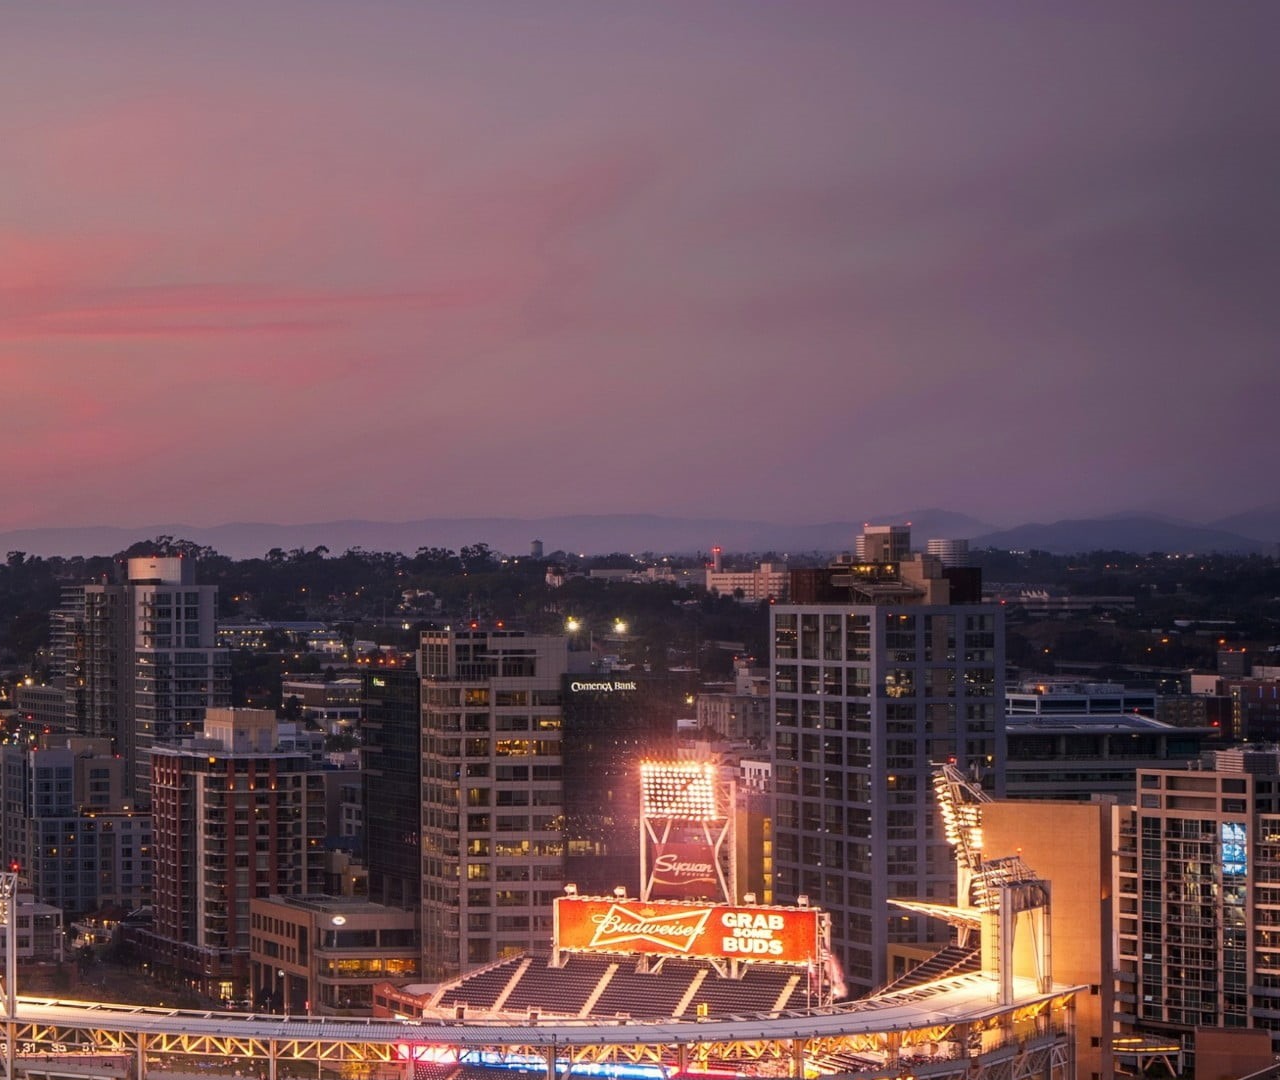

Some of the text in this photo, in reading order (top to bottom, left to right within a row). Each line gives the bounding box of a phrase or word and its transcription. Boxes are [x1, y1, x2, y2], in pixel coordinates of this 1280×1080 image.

[614, 681, 637, 691] Bank
[655, 854, 714, 878] Sycuan
[592, 913, 706, 937] Budweiser
[721, 912, 785, 931] GRAB
[732, 927, 774, 940] SOME
[722, 936, 784, 955] BUDS
